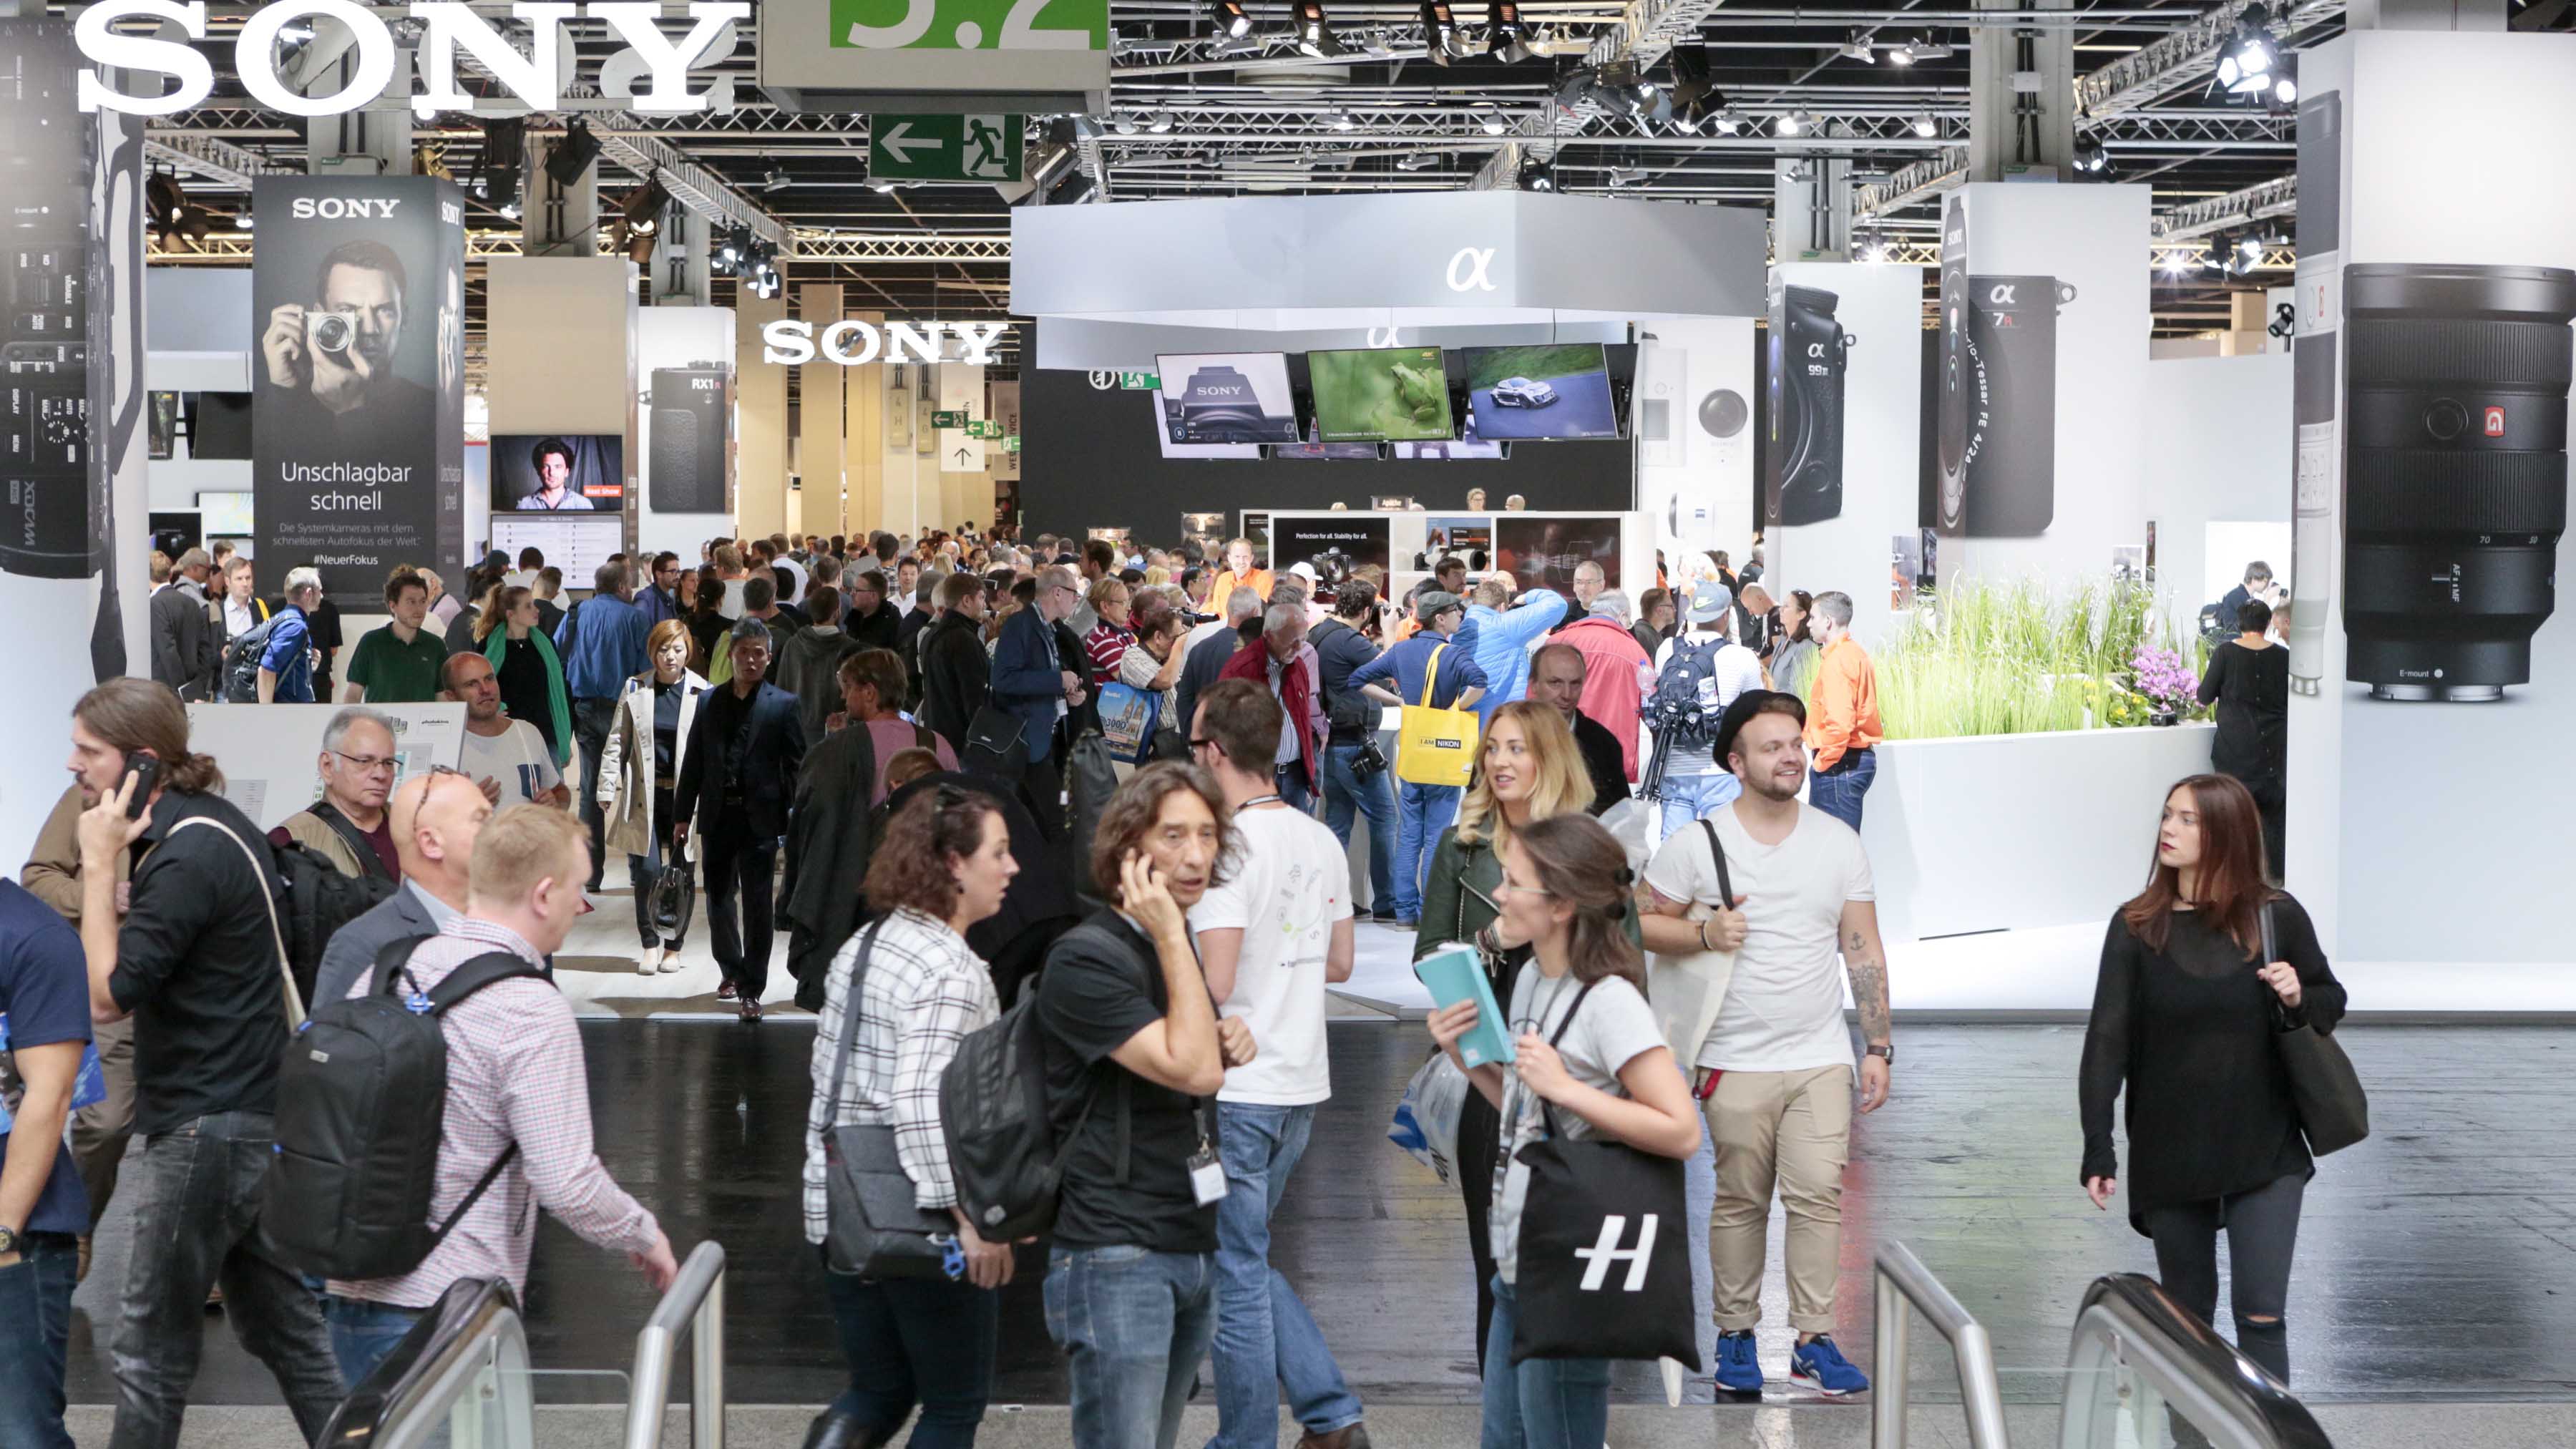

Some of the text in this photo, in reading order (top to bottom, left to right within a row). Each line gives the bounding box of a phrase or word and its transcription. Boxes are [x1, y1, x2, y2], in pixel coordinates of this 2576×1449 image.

[76, 0, 750, 117] SONY
[292, 197, 400, 218] SONY
[441, 201, 460, 225] SONY
[763, 319, 1009, 366] SONY
[1196, 386, 1241, 396] SONY
[1978, 412, 1989, 428] FE
[281, 462, 412, 486] Unschlagbar
[311, 490, 381, 510] schnell
[25, 481, 35, 545] XDCAM
[279, 523, 414, 535] Die Systemkameras mit dem
[1334, 532, 1352, 541] Stability
[272, 536, 325, 546] schnellsten
[327, 536, 374, 546] Autofokus
[377, 536, 393, 546] der
[313, 555, 379, 565] #NeuerFokus
[2451, 563, 2461, 602] AF MF
[2399, 668, 2429, 678] E-mount
